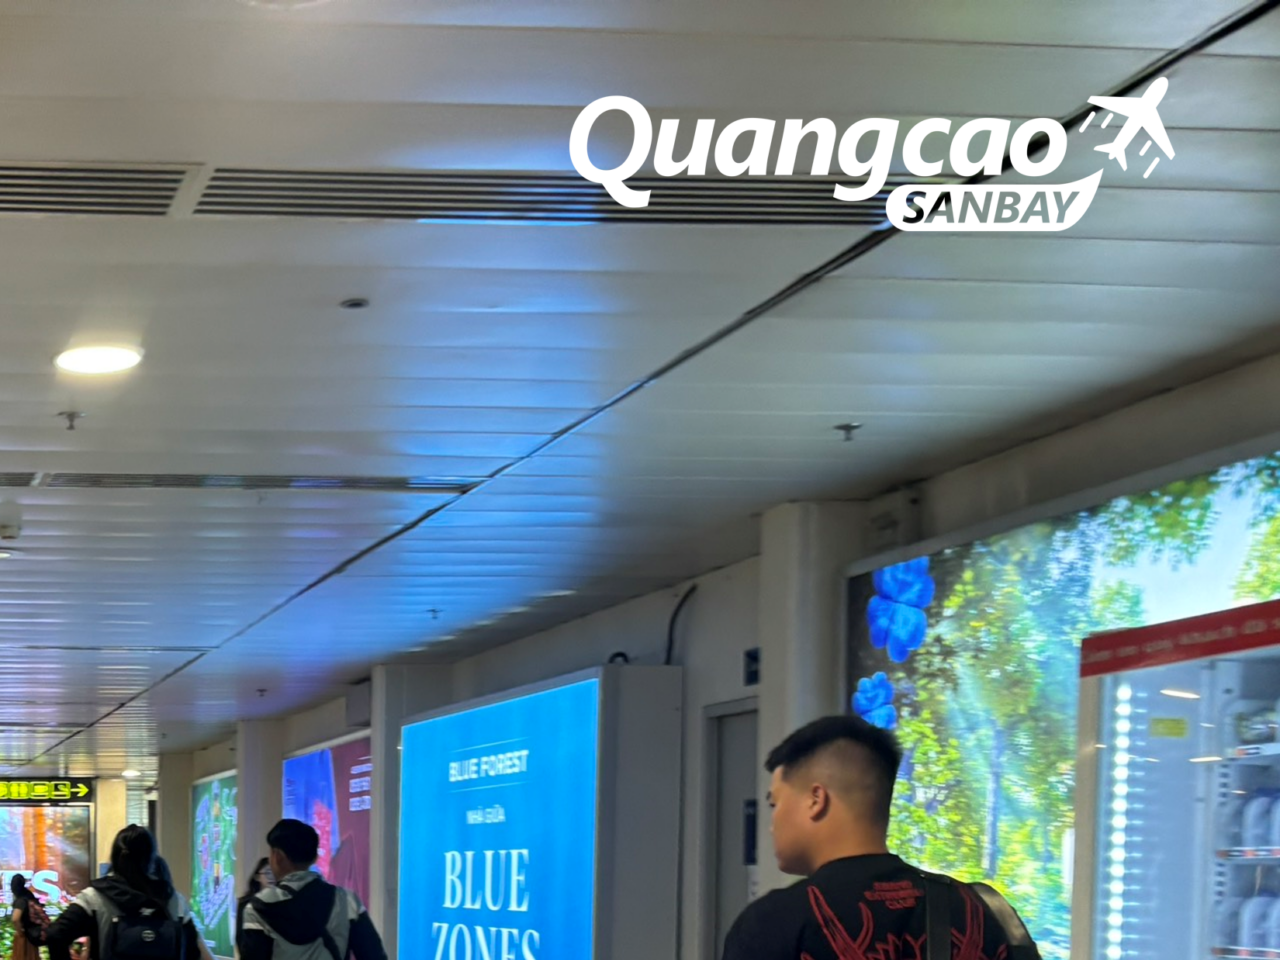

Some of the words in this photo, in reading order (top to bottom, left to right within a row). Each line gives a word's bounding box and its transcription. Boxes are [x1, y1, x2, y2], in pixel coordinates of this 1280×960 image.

[448, 758, 479, 782] BLUE
[480, 749, 530, 777] FOREST
[442, 849, 529, 912] BLUE
